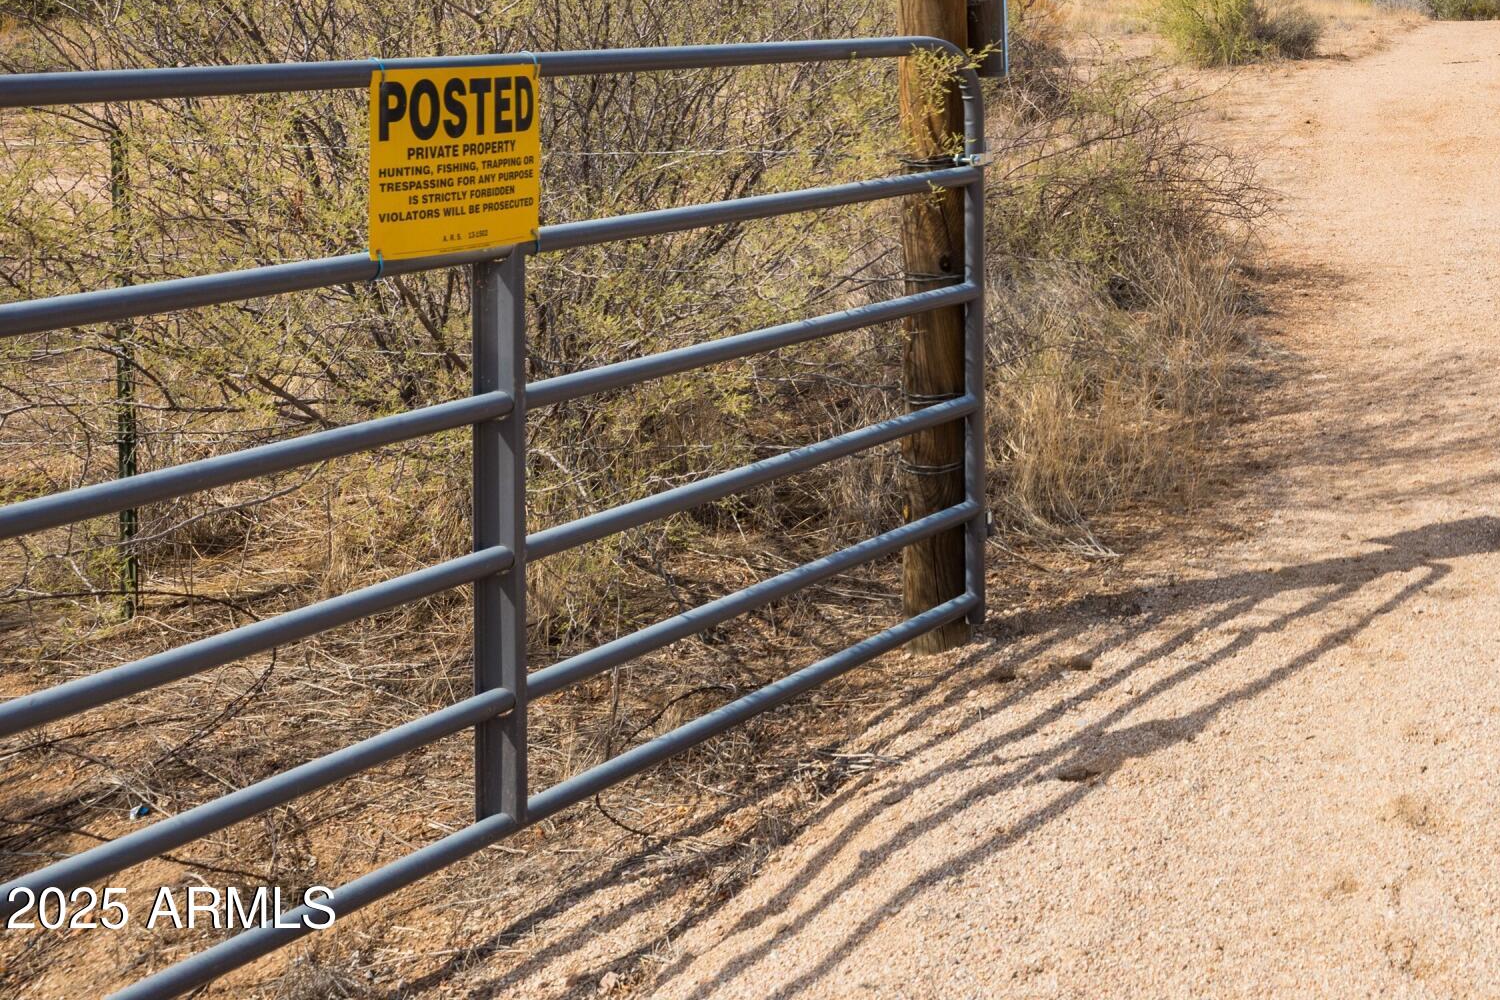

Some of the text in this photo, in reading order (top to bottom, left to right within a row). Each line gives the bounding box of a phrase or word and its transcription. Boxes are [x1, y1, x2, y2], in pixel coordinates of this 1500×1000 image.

[378, 75, 534, 141] POSTED
[407, 140, 516, 160] PRIVATE PROPERTY
[378, 156, 534, 178] HUNTING, FISHING, TRAPPING OR
[379, 169, 534, 193] TRESPASSING FOR ANY PURPOSE
[408, 185, 515, 205] IS STRICTLY FORBIDDEN
[378, 197, 534, 223] VIOLATORS WILL BE PROSECUTED
